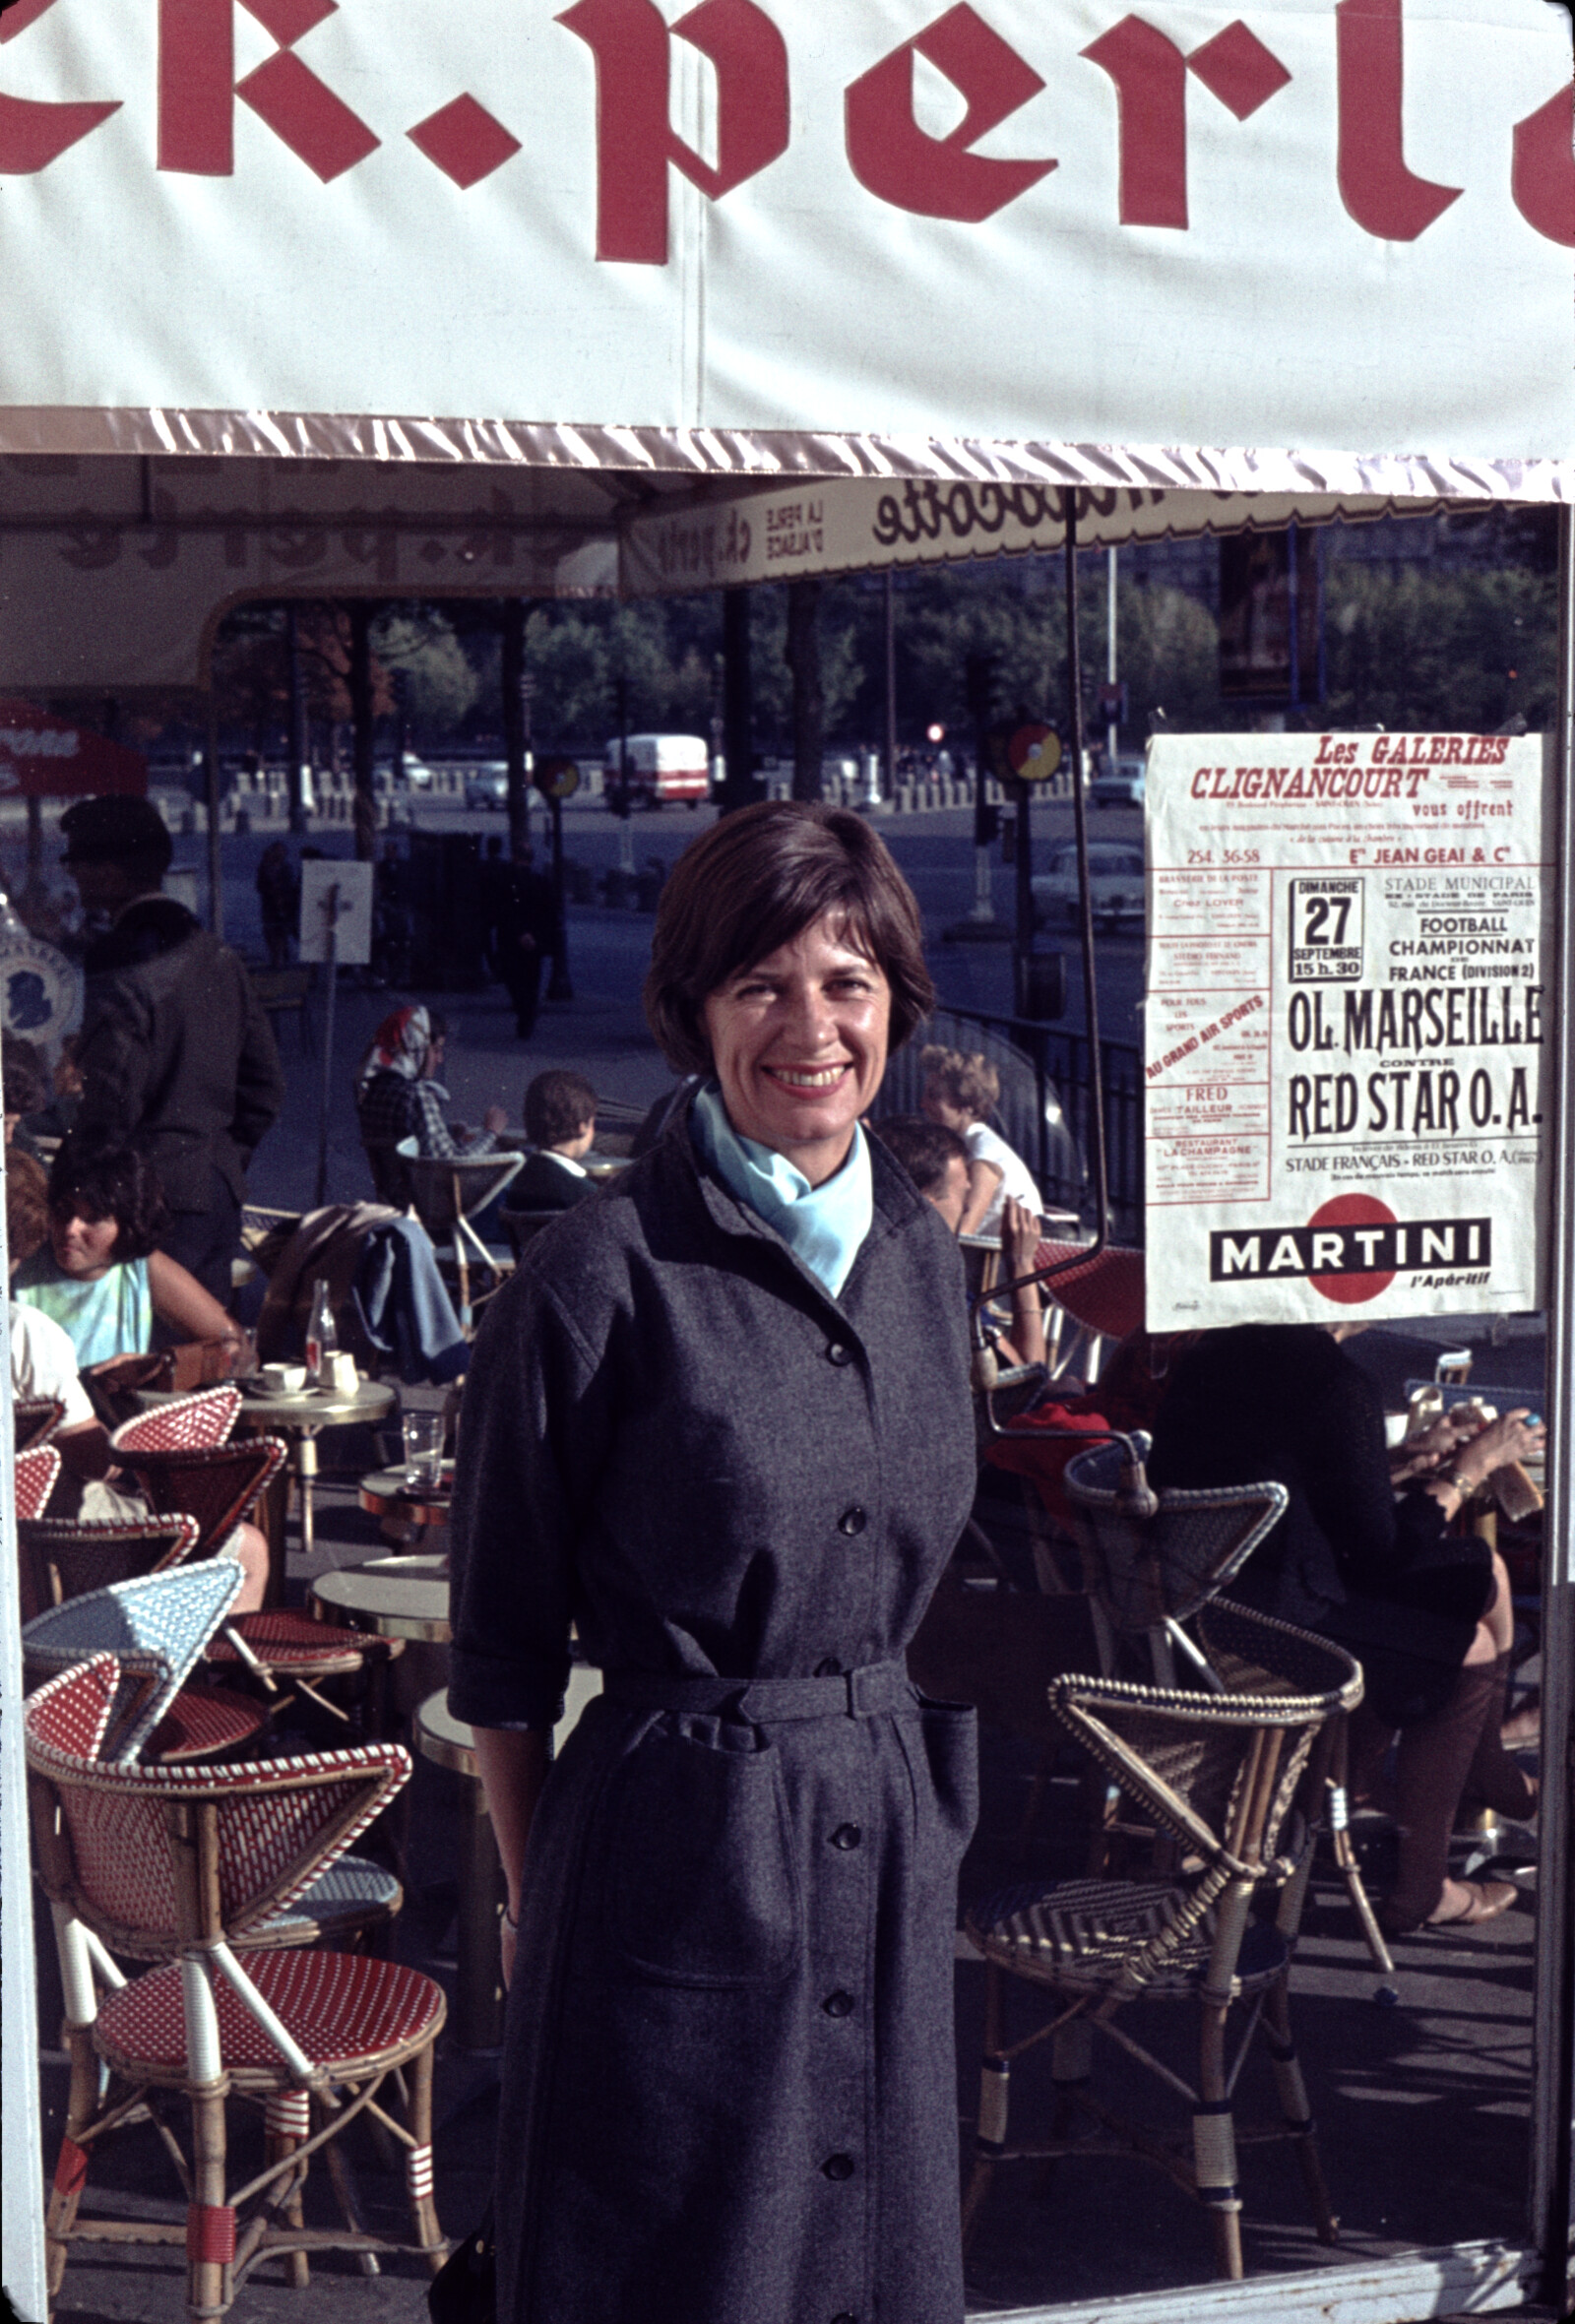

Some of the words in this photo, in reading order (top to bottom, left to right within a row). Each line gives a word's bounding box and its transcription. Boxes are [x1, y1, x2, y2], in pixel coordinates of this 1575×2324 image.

[1314, 736, 1357, 765] Les
[1371, 736, 1511, 765] GALERIES
[1190, 768, 1429, 798] CLIGNANCOURT
[1412, 803, 1447, 817] vous
[1456, 799, 1513, 820] offrent
[1374, 848, 1419, 863] JEAN
[1424, 848, 1465, 863] GEAI
[1472, 847, 1485, 863] &
[1298, 881, 1359, 894] DIMANCHE
[1384, 877, 1437, 891] STADE
[1446, 876, 1536, 891] MUNICIPAL
[1305, 897, 1352, 945] 27
[1420, 916, 1508, 933] FOOTBALL
[1293, 947, 1362, 961] SEPTEMBRE
[1389, 939, 1535, 956] CHAMPIONNAT
[1295, 963, 1314, 975] 15
[1318, 963, 1334, 975] h.
[1336, 962, 1360, 975] 30
[1389, 965, 1456, 981] FRANCE
[1462, 963, 1519, 981] (DIVISION
[1521, 963, 1535, 979] 2)
[1289, 991, 1339, 1051] OL.
[1344, 984, 1544, 1056] MARSEILLE
[1146, 1060, 1164, 1080] AU
[1162, 1036, 1199, 1067] GRAND
[1199, 1023, 1221, 1043] AIR
[1219, 994, 1264, 1030] SPORTS
[1379, 1057, 1455, 1069] CONTRE
[1186, 1087, 1228, 1101] FRED
[1176, 1104, 1232, 1114] TAILLEUR
[1288, 1074, 1358, 1142] RED
[1367, 1069, 1461, 1139] STAR
[1470, 1068, 1501, 1129] O.
[1507, 1067, 1544, 1136] A.
[1175, 1138, 1237, 1148] RESTAURANT
[1286, 1157, 1329, 1172] STADE
[1333, 1154, 1401, 1173] FRANÇAIS
[1413, 1152, 1440, 1167] RED
[1443, 1151, 1479, 1166] STAR
[1480, 1151, 1496, 1165] O.
[1221, 1225, 1480, 1275] MARTINI
[1411, 1271, 1491, 1289] l'Apéritif
